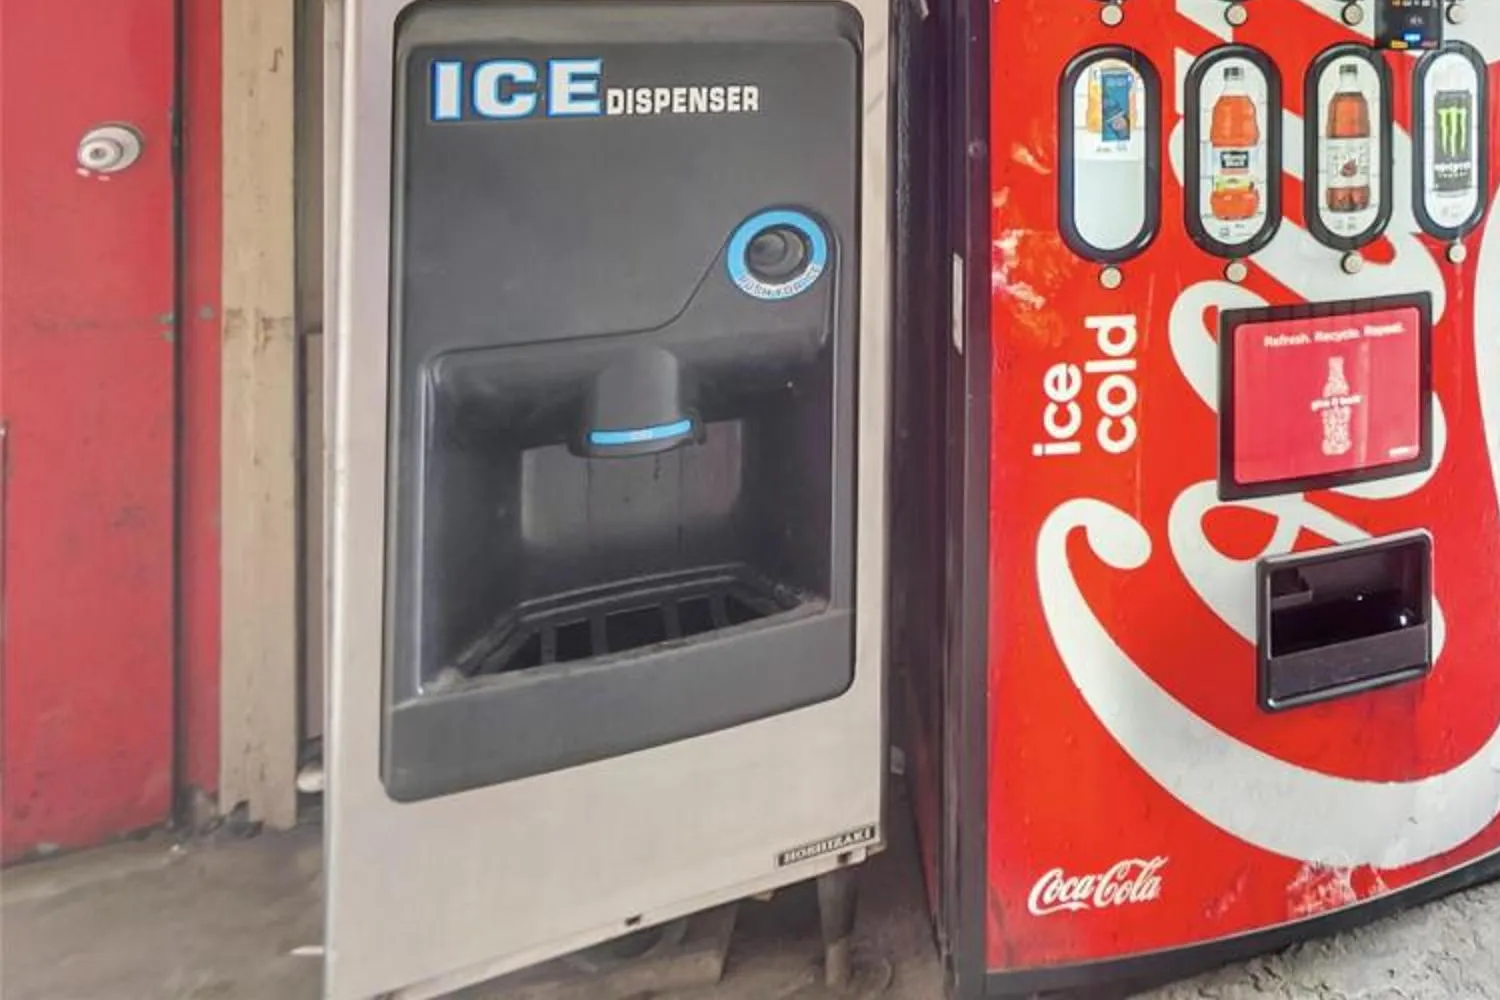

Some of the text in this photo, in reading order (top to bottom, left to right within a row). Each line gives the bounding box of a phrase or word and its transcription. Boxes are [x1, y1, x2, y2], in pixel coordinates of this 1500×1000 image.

[431, 59, 760, 122] ICE DISPENSER
[1033, 362, 1082, 456] ice
[1085, 314, 1137, 453] cold
[1027, 856, 1170, 917] Coca-Cola
